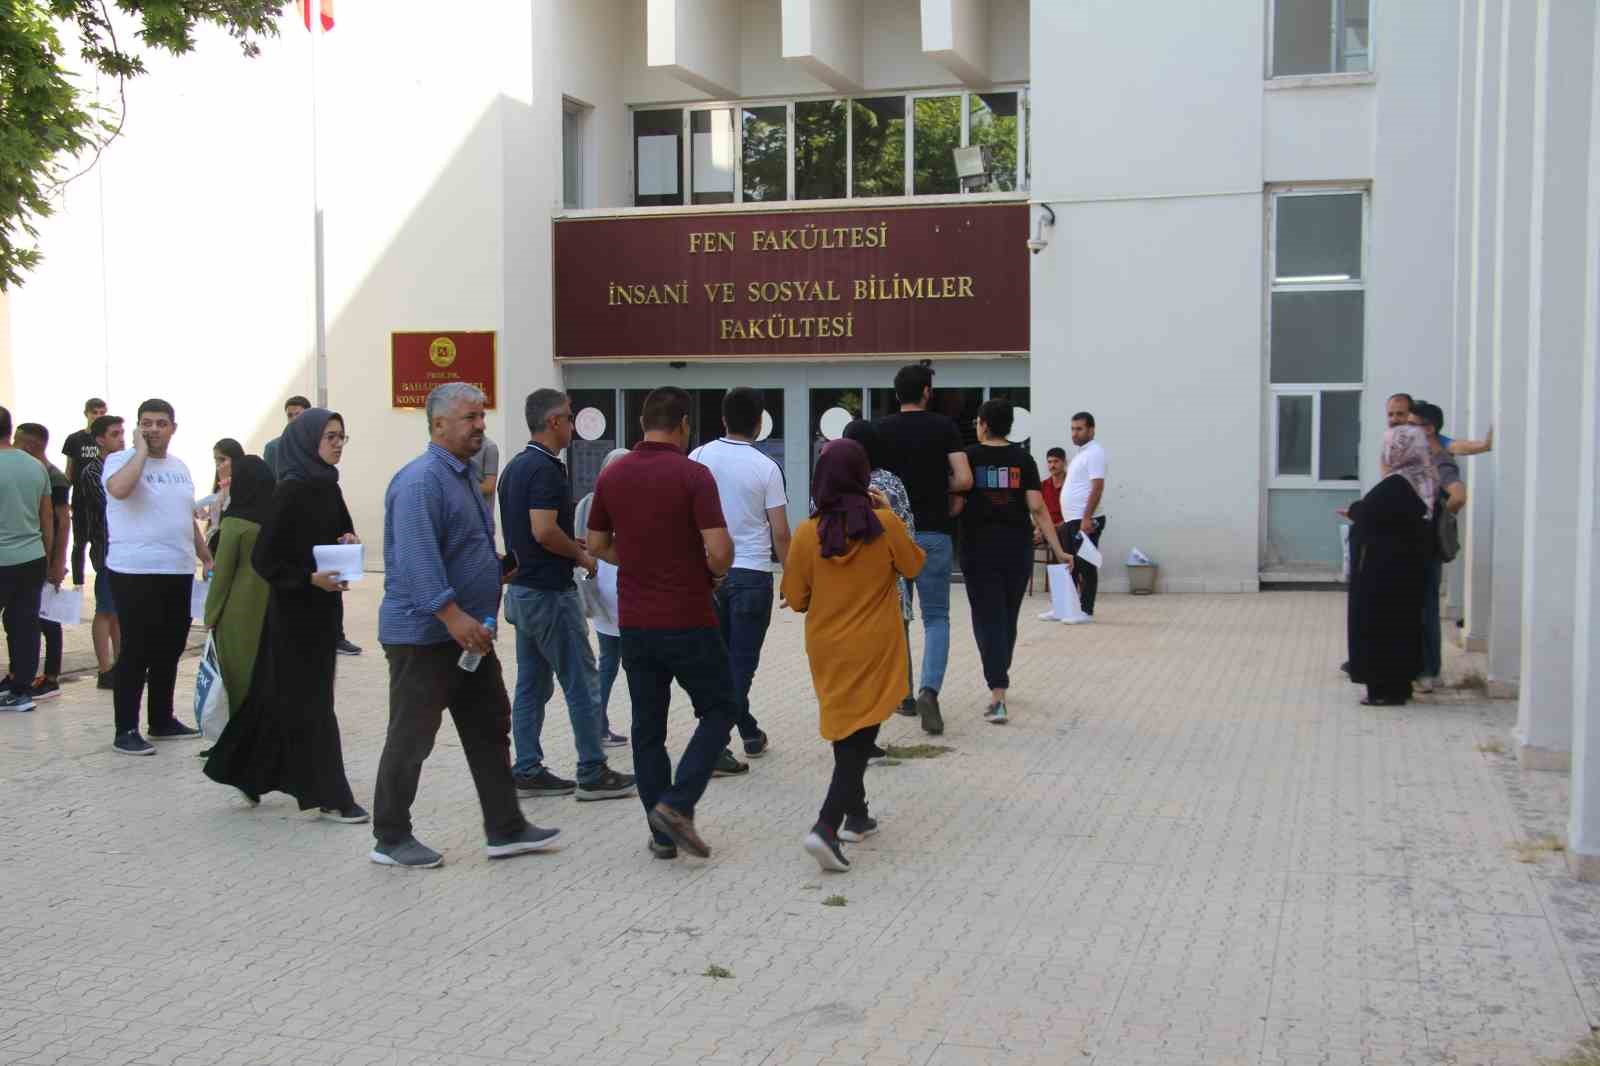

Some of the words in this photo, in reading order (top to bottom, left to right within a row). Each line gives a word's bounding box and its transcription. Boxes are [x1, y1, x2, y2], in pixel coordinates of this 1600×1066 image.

[688, 231, 735, 253] FEN
[751, 222, 888, 251] FAKÜLTESİ
[608, 280, 689, 305] İNSANİ
[703, 282, 736, 303] VE
[747, 281, 841, 302] SOSYAL
[853, 272, 975, 300] BİLİMLER
[720, 311, 855, 340] FAKÜLTESİ
